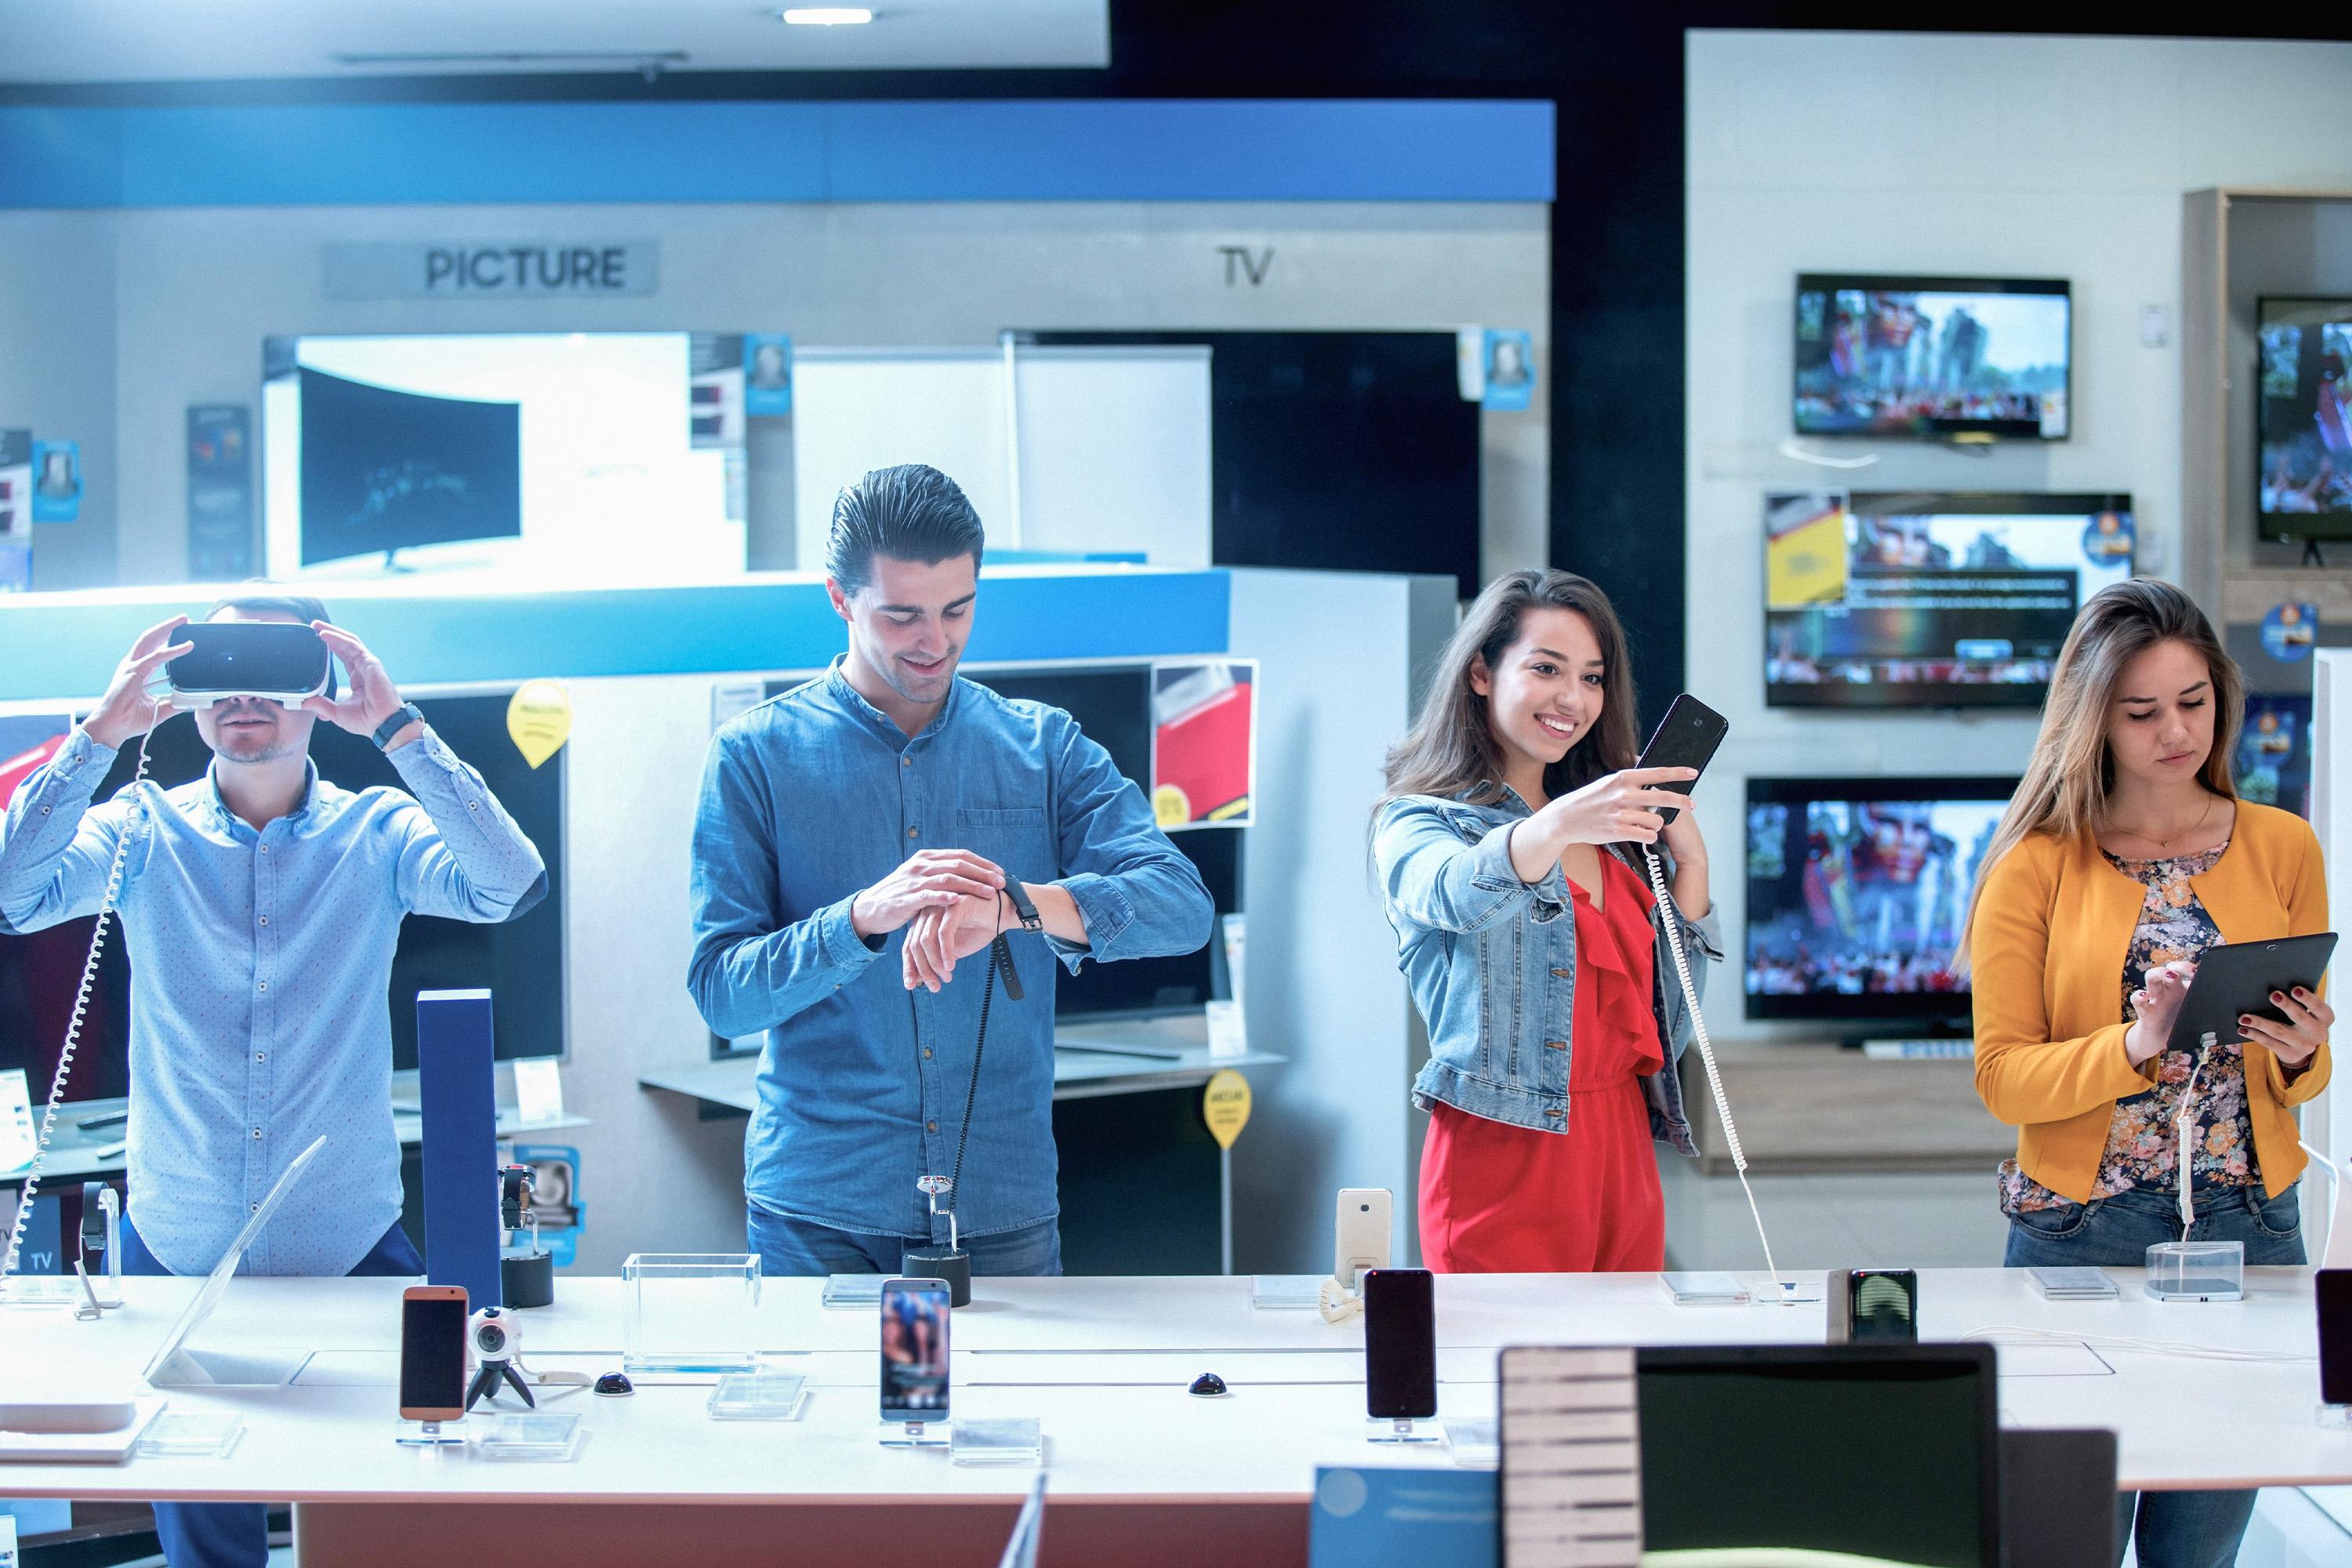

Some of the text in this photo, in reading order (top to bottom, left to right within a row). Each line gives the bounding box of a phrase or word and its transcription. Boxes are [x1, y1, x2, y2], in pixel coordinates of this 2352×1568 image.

[426, 248, 625, 289] PICTURE
[1216, 245, 1274, 287] TV
[31, 1251, 53, 1270] TV
